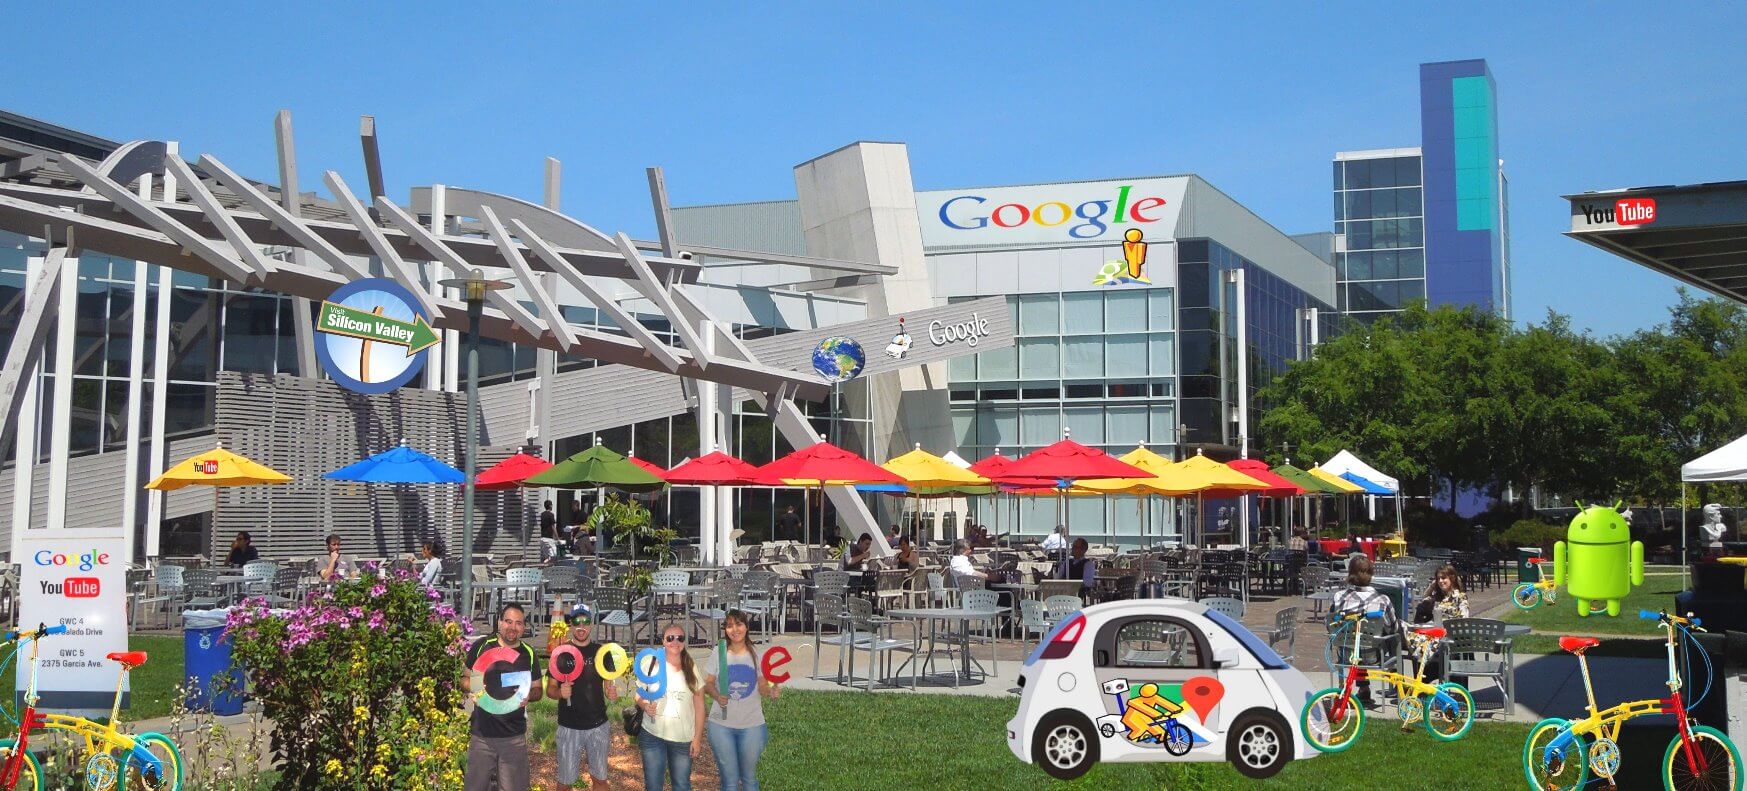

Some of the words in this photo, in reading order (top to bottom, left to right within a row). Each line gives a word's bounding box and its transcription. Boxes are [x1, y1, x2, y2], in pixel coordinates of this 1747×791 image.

[938, 184, 1167, 239] Google
[1580, 203, 1654, 225] YouTube
[330, 306, 346, 316] Visit
[327, 313, 372, 334] Silicon
[375, 321, 415, 343] Valley
[929, 312, 990, 347] Google
[193, 461, 218, 473] YouTube
[34, 548, 110, 572] Google
[39, 580, 98, 595] YouTube
[59, 617, 77, 625] GWC
[79, 617, 84, 625] 4
[85, 627, 103, 636] Drive
[59, 649, 78, 657] GWC
[79, 649, 85, 657] 5
[41, 660, 61, 668] 2375
[62, 660, 86, 668] Garcia
[87, 660, 103, 668] Ave.
